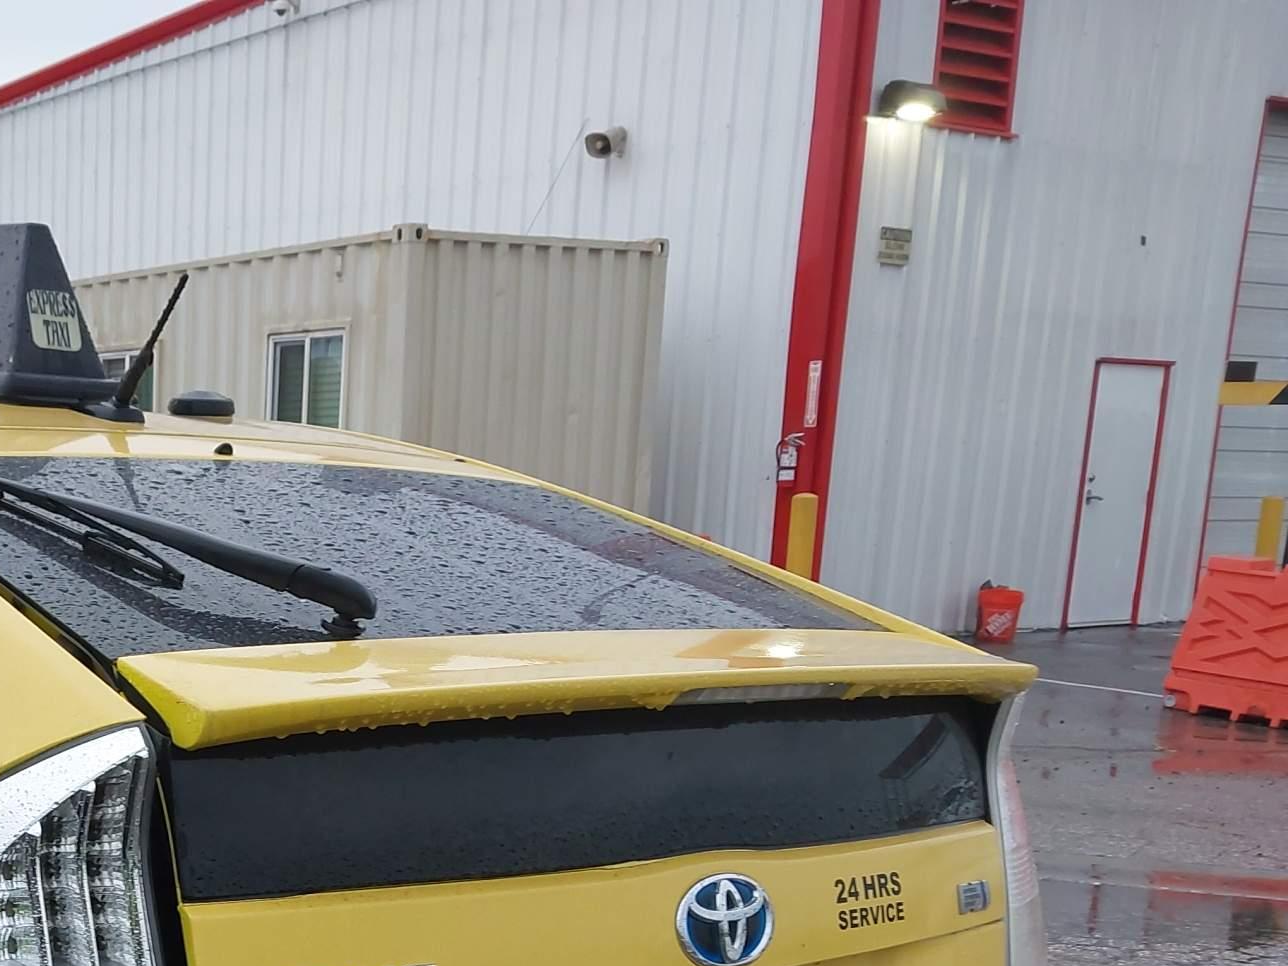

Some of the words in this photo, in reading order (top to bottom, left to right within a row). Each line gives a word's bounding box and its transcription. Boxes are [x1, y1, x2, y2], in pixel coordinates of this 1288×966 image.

[28, 290, 76, 318] EXPRESS
[43, 319, 71, 348] TAXI
[834, 876, 859, 904] 24
[862, 871, 902, 900] HRS
[838, 901, 905, 930] SERVICE
